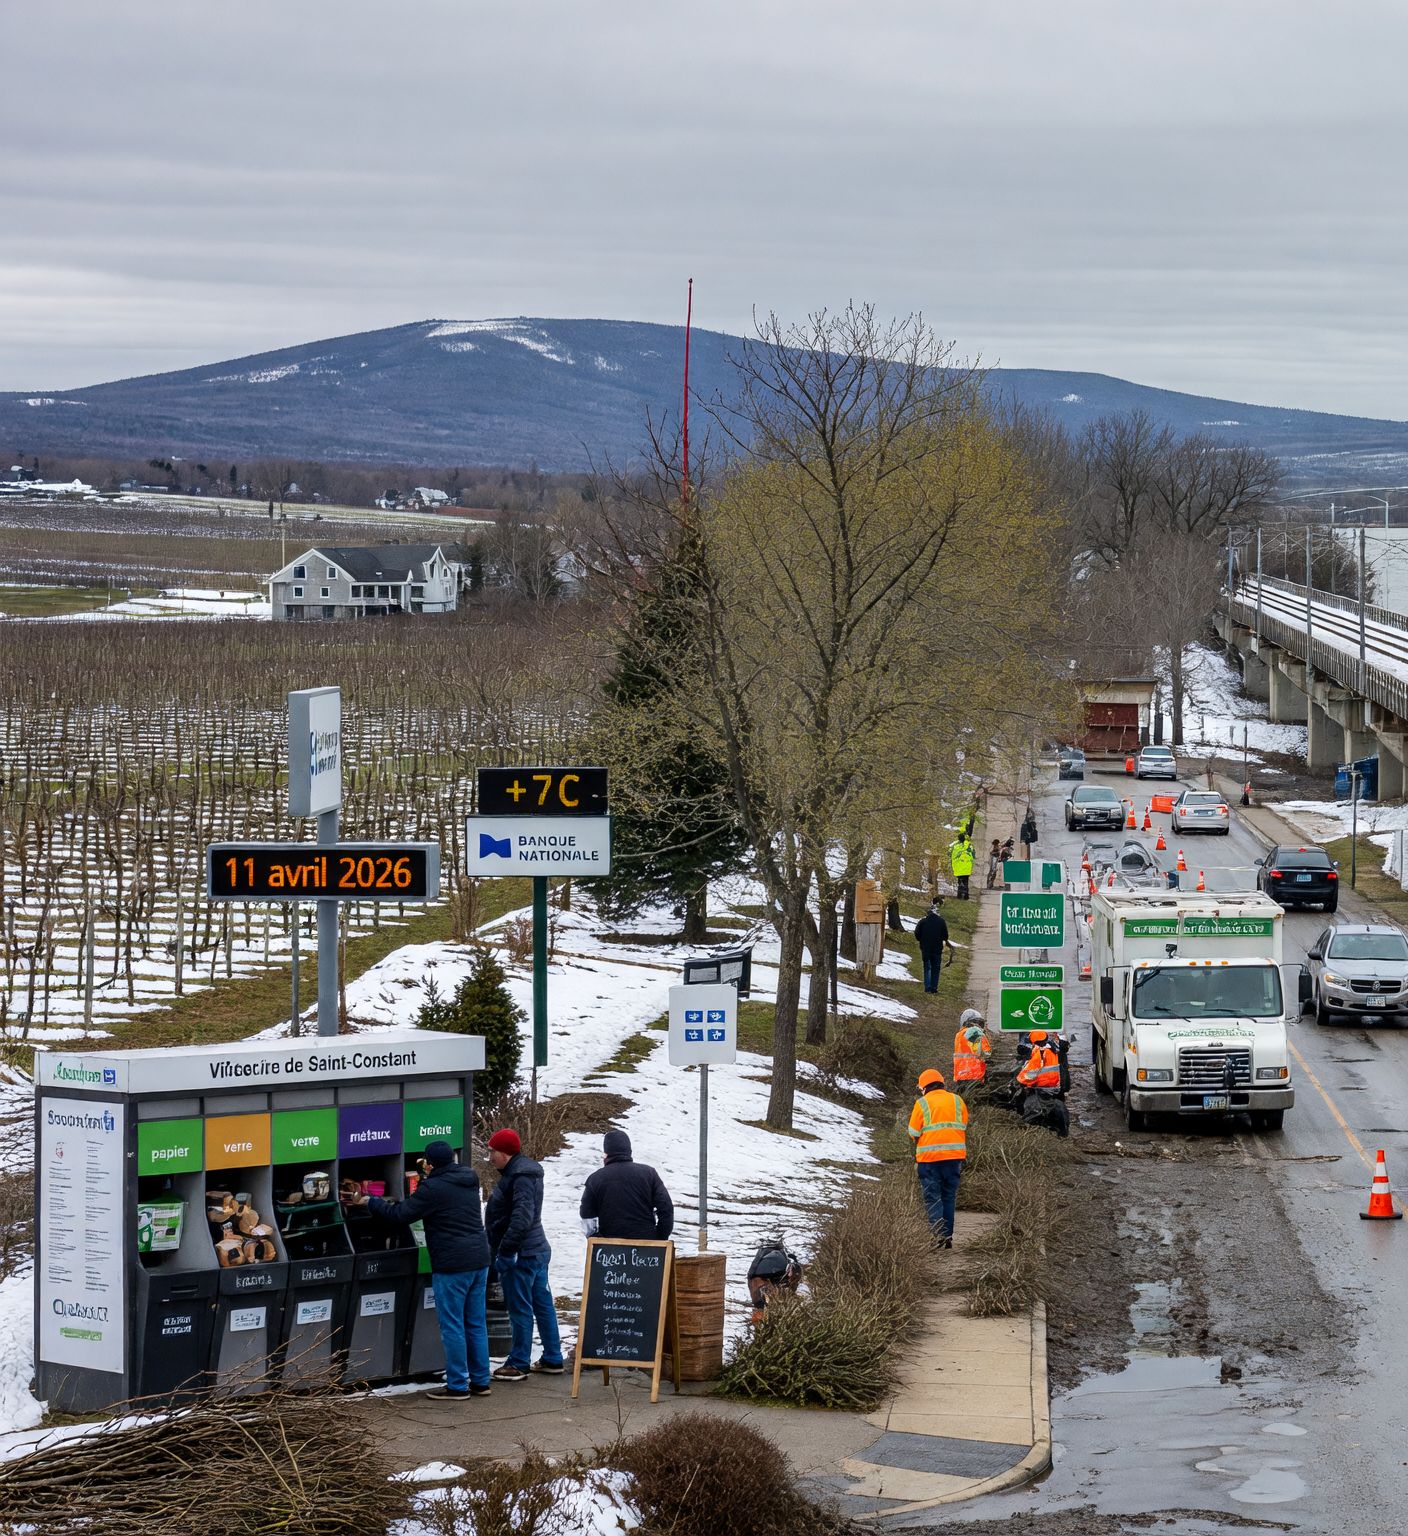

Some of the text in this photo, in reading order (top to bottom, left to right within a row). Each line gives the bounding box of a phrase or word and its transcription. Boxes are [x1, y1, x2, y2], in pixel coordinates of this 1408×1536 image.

[506, 774, 580, 807] +7C
[518, 836, 576, 846] BANQUE
[519, 850, 599, 861] NATIONALE
[226, 857, 412, 888] 11 avril 2026
[284, 1057, 303, 1073] de
[308, 1050, 417, 1071] Saint-Constant
[223, 1141, 253, 1153] verre
[291, 1135, 320, 1147] verre
[151, 1144, 190, 1163] papier
